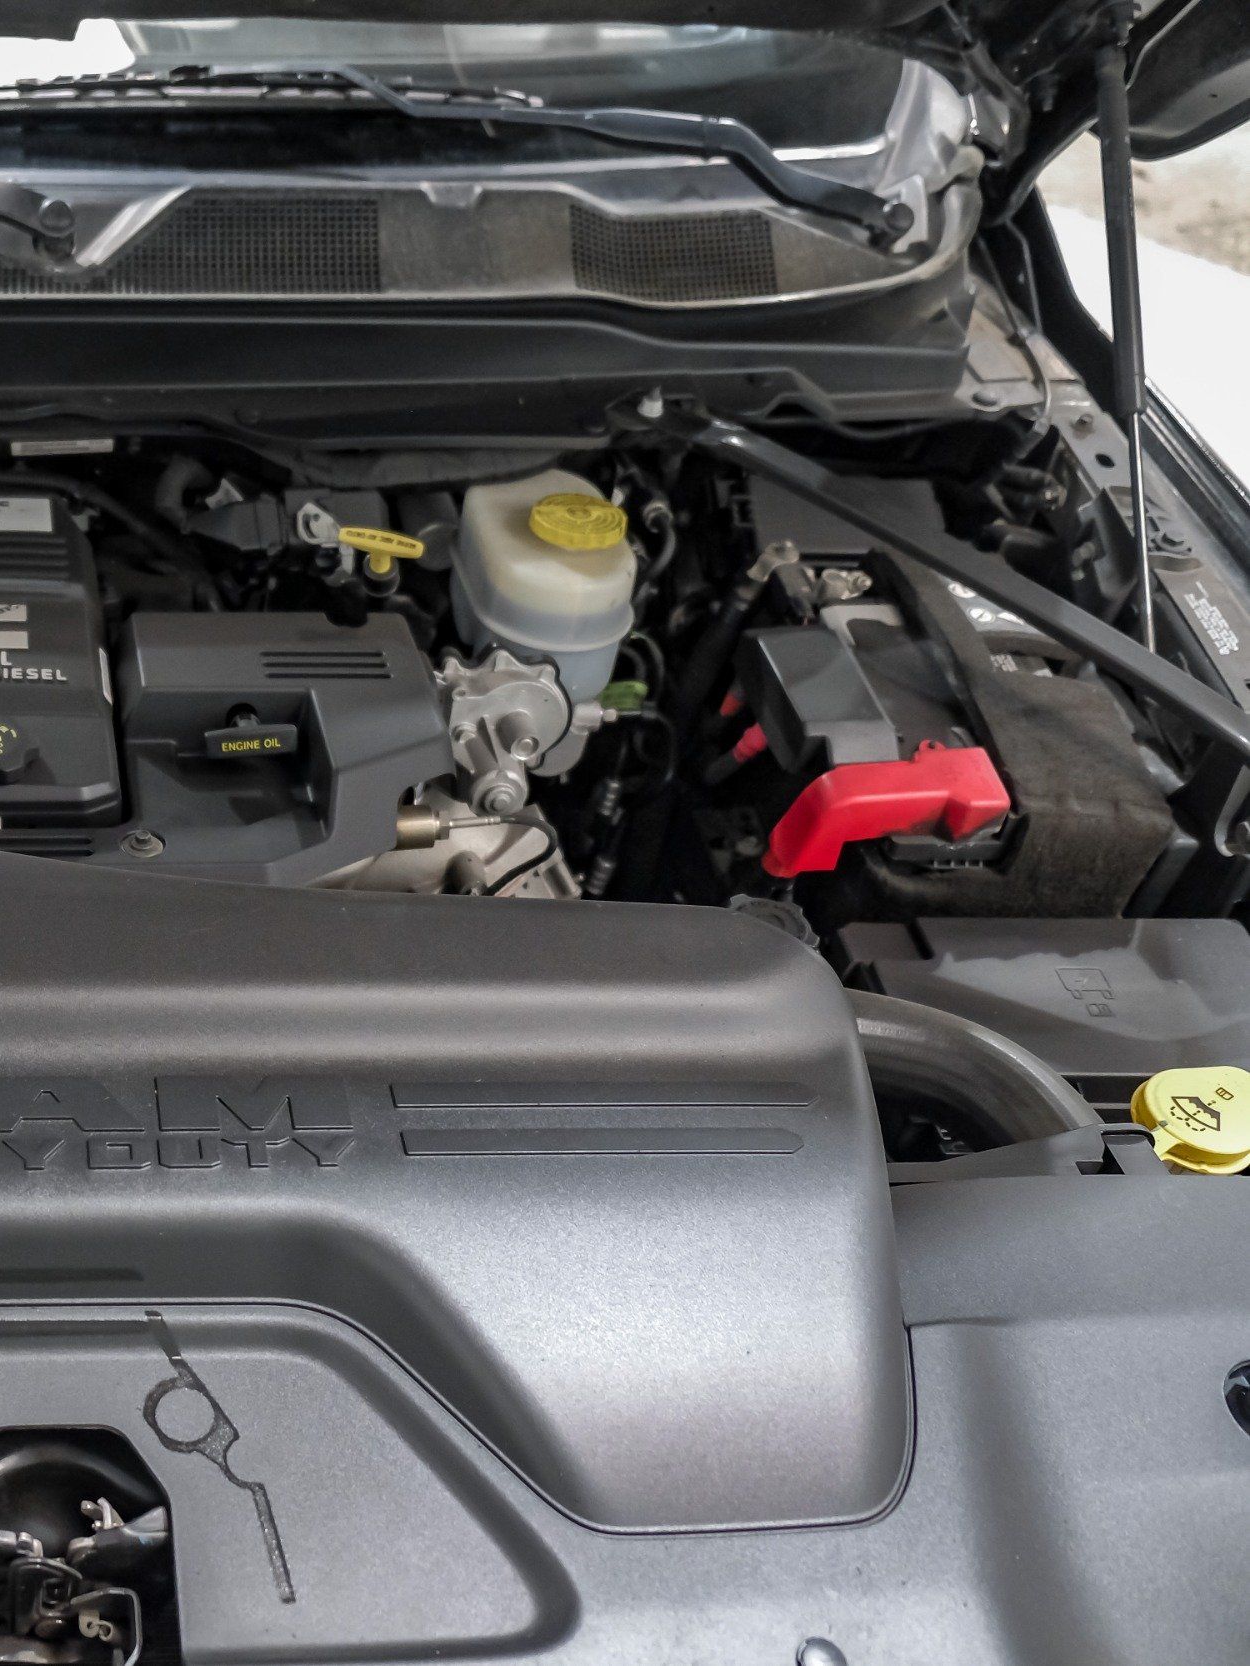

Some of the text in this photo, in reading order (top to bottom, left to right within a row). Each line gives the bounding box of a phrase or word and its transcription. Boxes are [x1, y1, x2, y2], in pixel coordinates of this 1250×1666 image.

[221, 738, 281, 752] ENGINE OIL
[86, 1137, 355, 1170] DUTY
